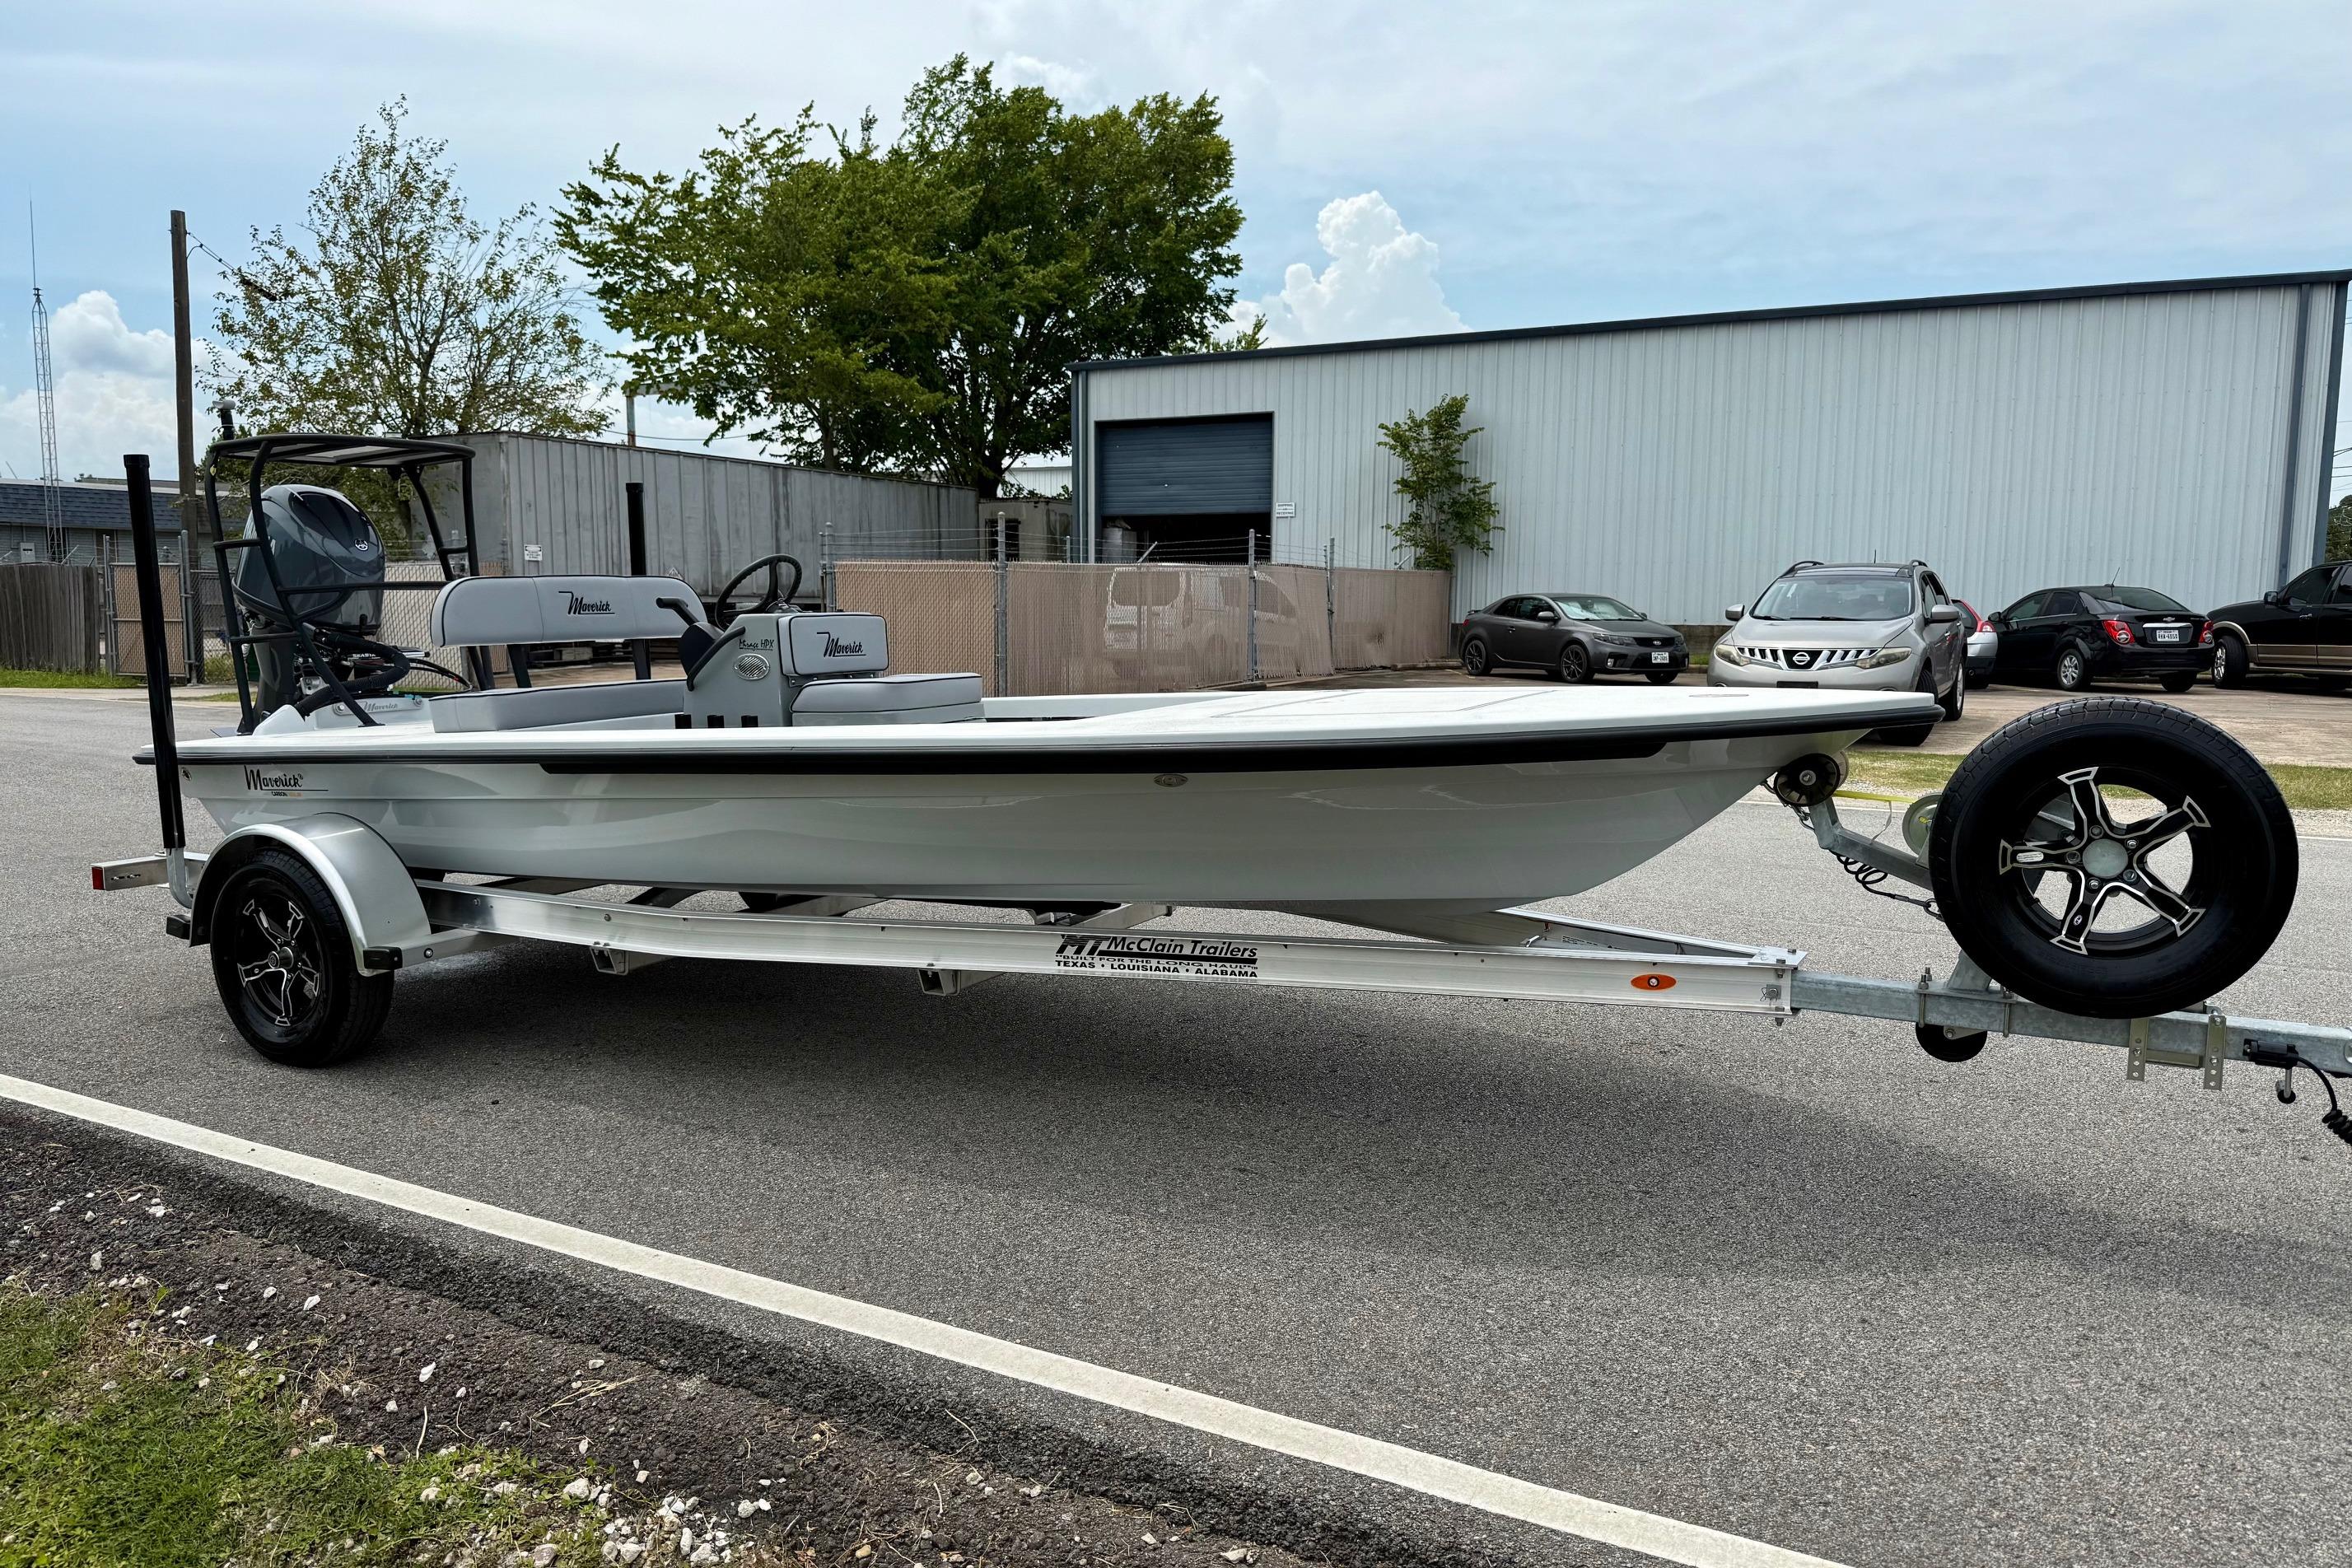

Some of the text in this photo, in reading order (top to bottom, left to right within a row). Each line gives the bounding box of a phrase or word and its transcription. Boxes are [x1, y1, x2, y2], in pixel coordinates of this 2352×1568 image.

[558, 590, 615, 615] Maverick
[817, 631, 867, 658] Maverick
[1107, 936, 1258, 958] McClain Trailers
[1055, 959, 1258, 978] TEXAS LOUISIANA ALABAMA
